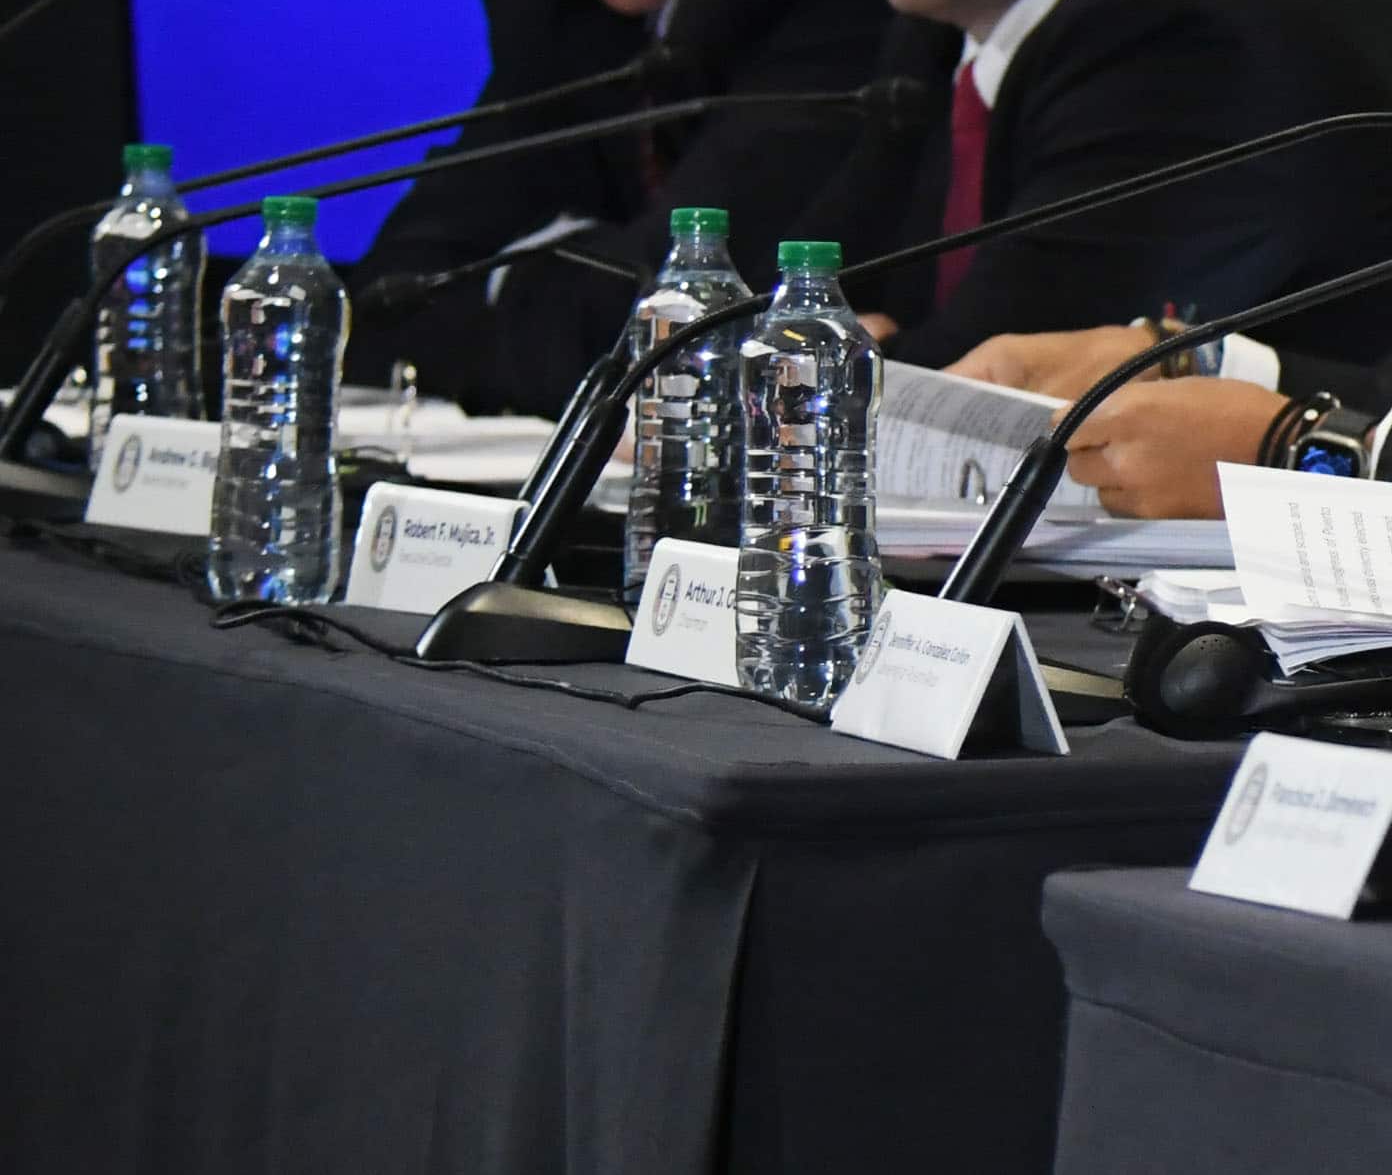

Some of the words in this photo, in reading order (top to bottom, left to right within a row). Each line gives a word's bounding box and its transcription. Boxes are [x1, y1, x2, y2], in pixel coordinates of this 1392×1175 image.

[404, 518, 437, 540] Robert
[1321, 506, 1334, 534] Puerto
[1352, 511, 1368, 544] elected
[685, 580, 716, 605] Arthur
[715, 586, 725, 607] J.
